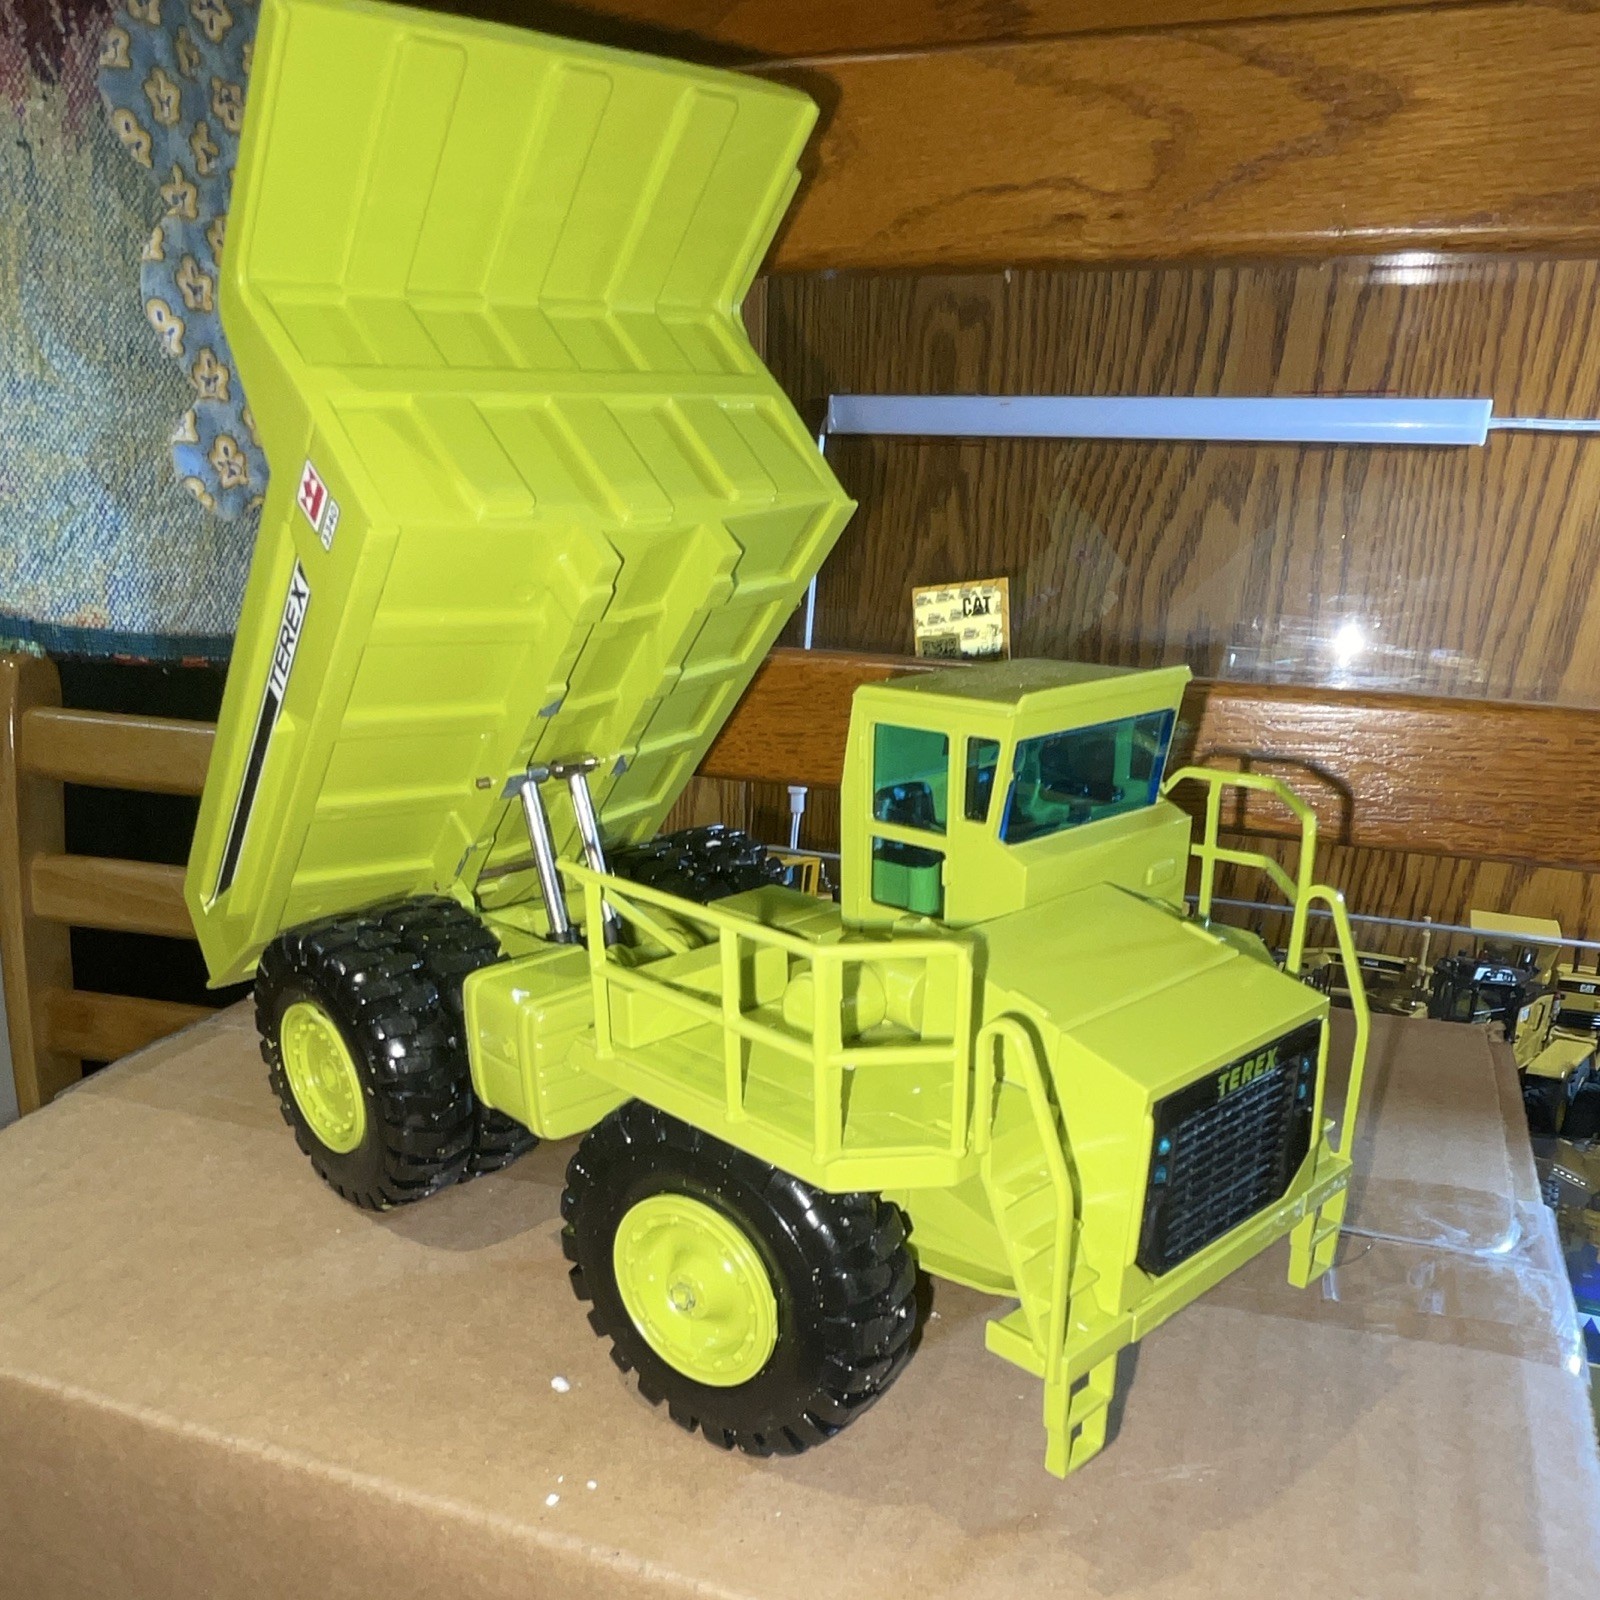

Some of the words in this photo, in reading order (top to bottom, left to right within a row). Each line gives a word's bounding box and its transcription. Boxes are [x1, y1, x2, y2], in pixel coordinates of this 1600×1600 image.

[962, 596, 991, 617] CAT
[269, 576, 307, 692] TEREX
[1217, 1046, 1278, 1099] TEREX
